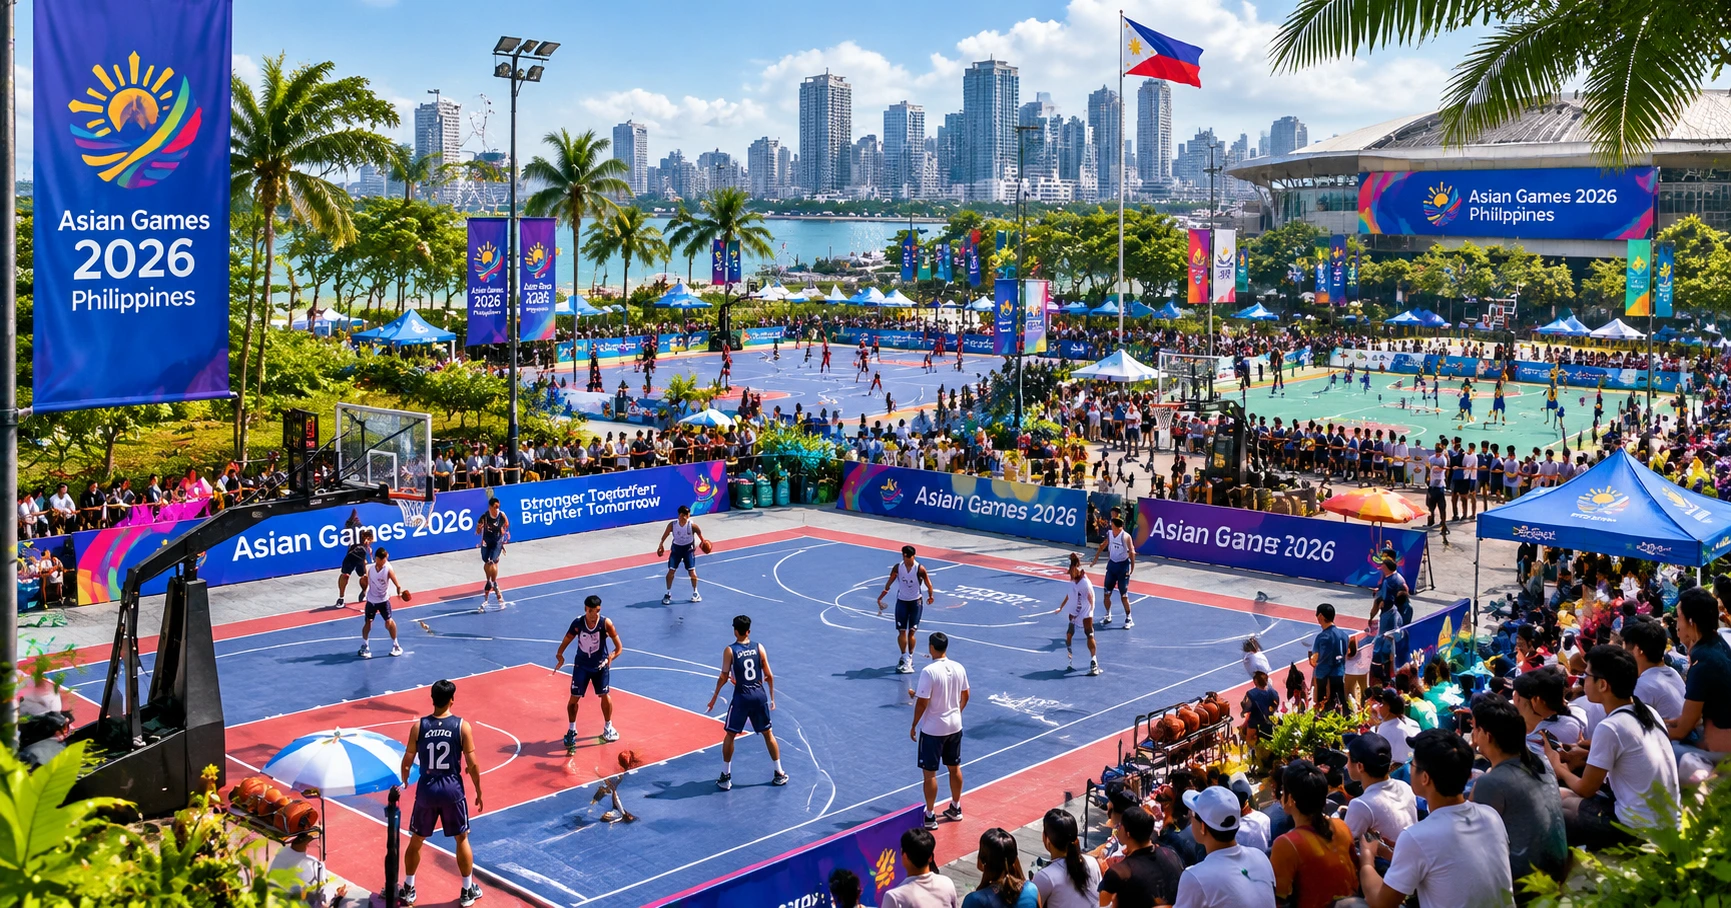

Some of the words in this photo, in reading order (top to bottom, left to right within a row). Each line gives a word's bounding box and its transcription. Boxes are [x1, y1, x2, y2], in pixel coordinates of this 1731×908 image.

[1469, 189, 1511, 204] Asian
[1515, 188, 1571, 204] Games
[1575, 188, 1618, 204] 2026
[57, 209, 124, 231] Asian
[131, 209, 210, 230] Games
[73, 237, 195, 280] 2026
[72, 286, 196, 313] Philippines
[474, 295, 501, 308] 2026
[522, 507, 583, 526] Brighter
[915, 486, 964, 511] Asian
[968, 495, 1027, 520] Games
[1031, 503, 1077, 527] 2026
[232, 530, 311, 562] Asian
[319, 521, 406, 549] Games
[412, 508, 473, 537] 2026
[1150, 516, 1209, 545] Asian
[1284, 535, 1336, 563] 2026
[743, 658, 756, 681] 8
[426, 741, 450, 769] 12
